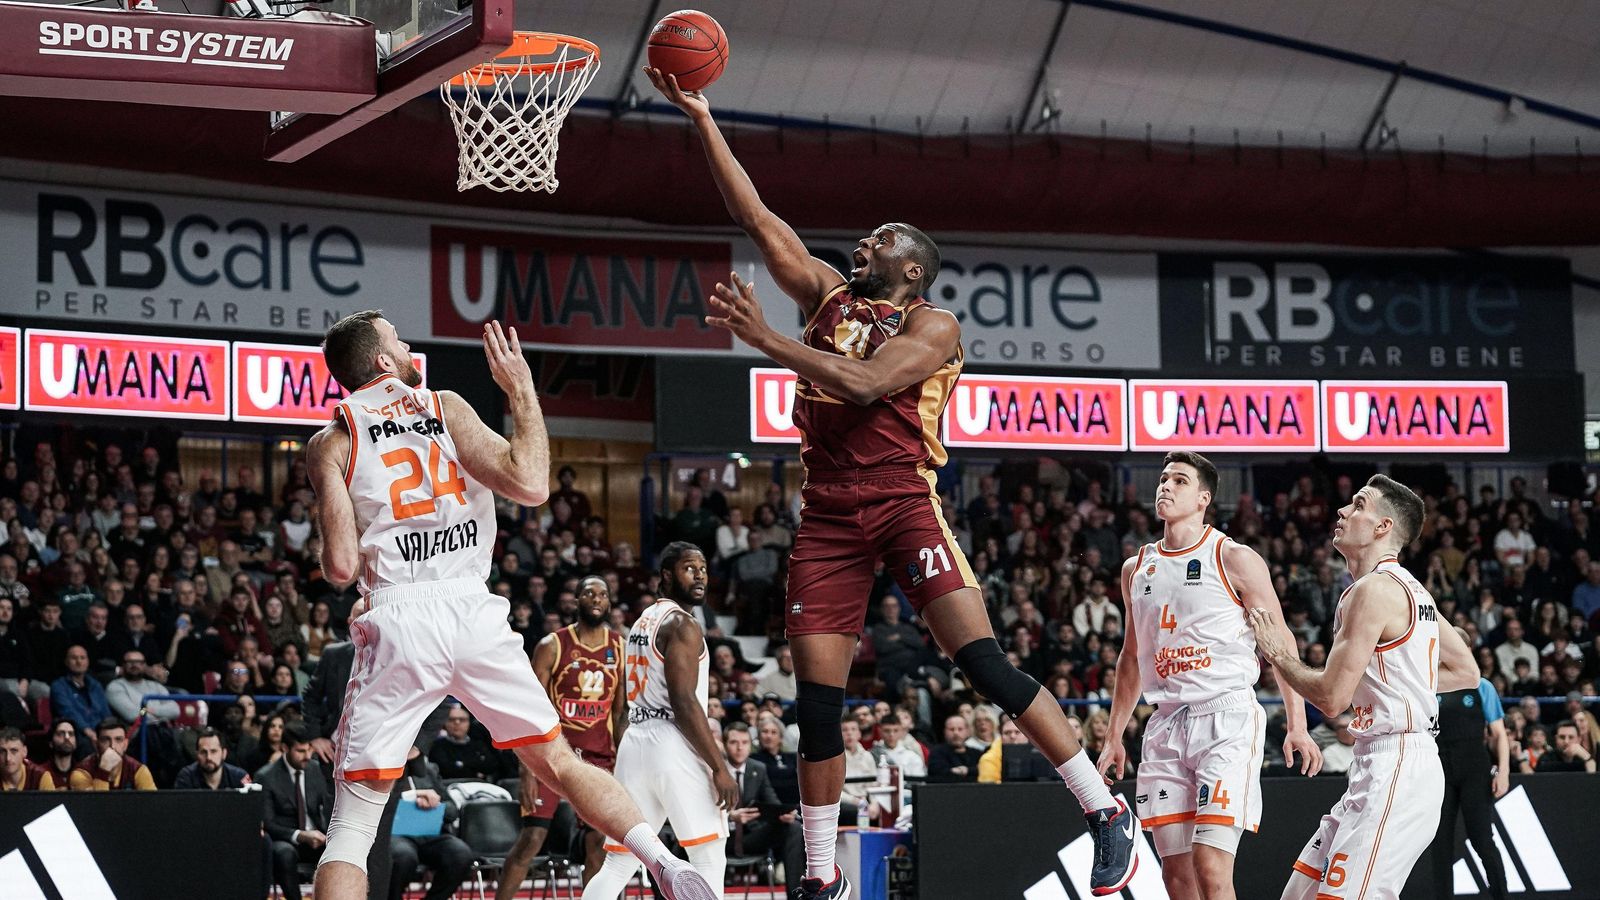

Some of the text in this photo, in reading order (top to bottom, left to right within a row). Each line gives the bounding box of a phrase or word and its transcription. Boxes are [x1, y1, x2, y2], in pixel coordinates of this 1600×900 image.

[450, 243, 710, 330] UMANA
[36, 289, 342, 330] PER STAR BEN
[839, 320, 874, 354] 21
[969, 339, 1105, 364] CORSO
[39, 342, 211, 401] UMANA
[1216, 344, 1524, 368] PER STAR BENE
[246, 354, 345, 411] UMA
[955, 384, 1109, 437] UMANA
[1142, 390, 1303, 440] UMANA
[1334, 391, 1492, 441] UMANA
[380, 441, 467, 521] 24
[919, 543, 952, 580] 21
[1161, 604, 1177, 634] 4
[1155, 646, 1209, 663] ultura del
[582, 669, 605, 692] 22
[1211, 779, 1230, 809] 4
[1326, 852, 1349, 888] 6
